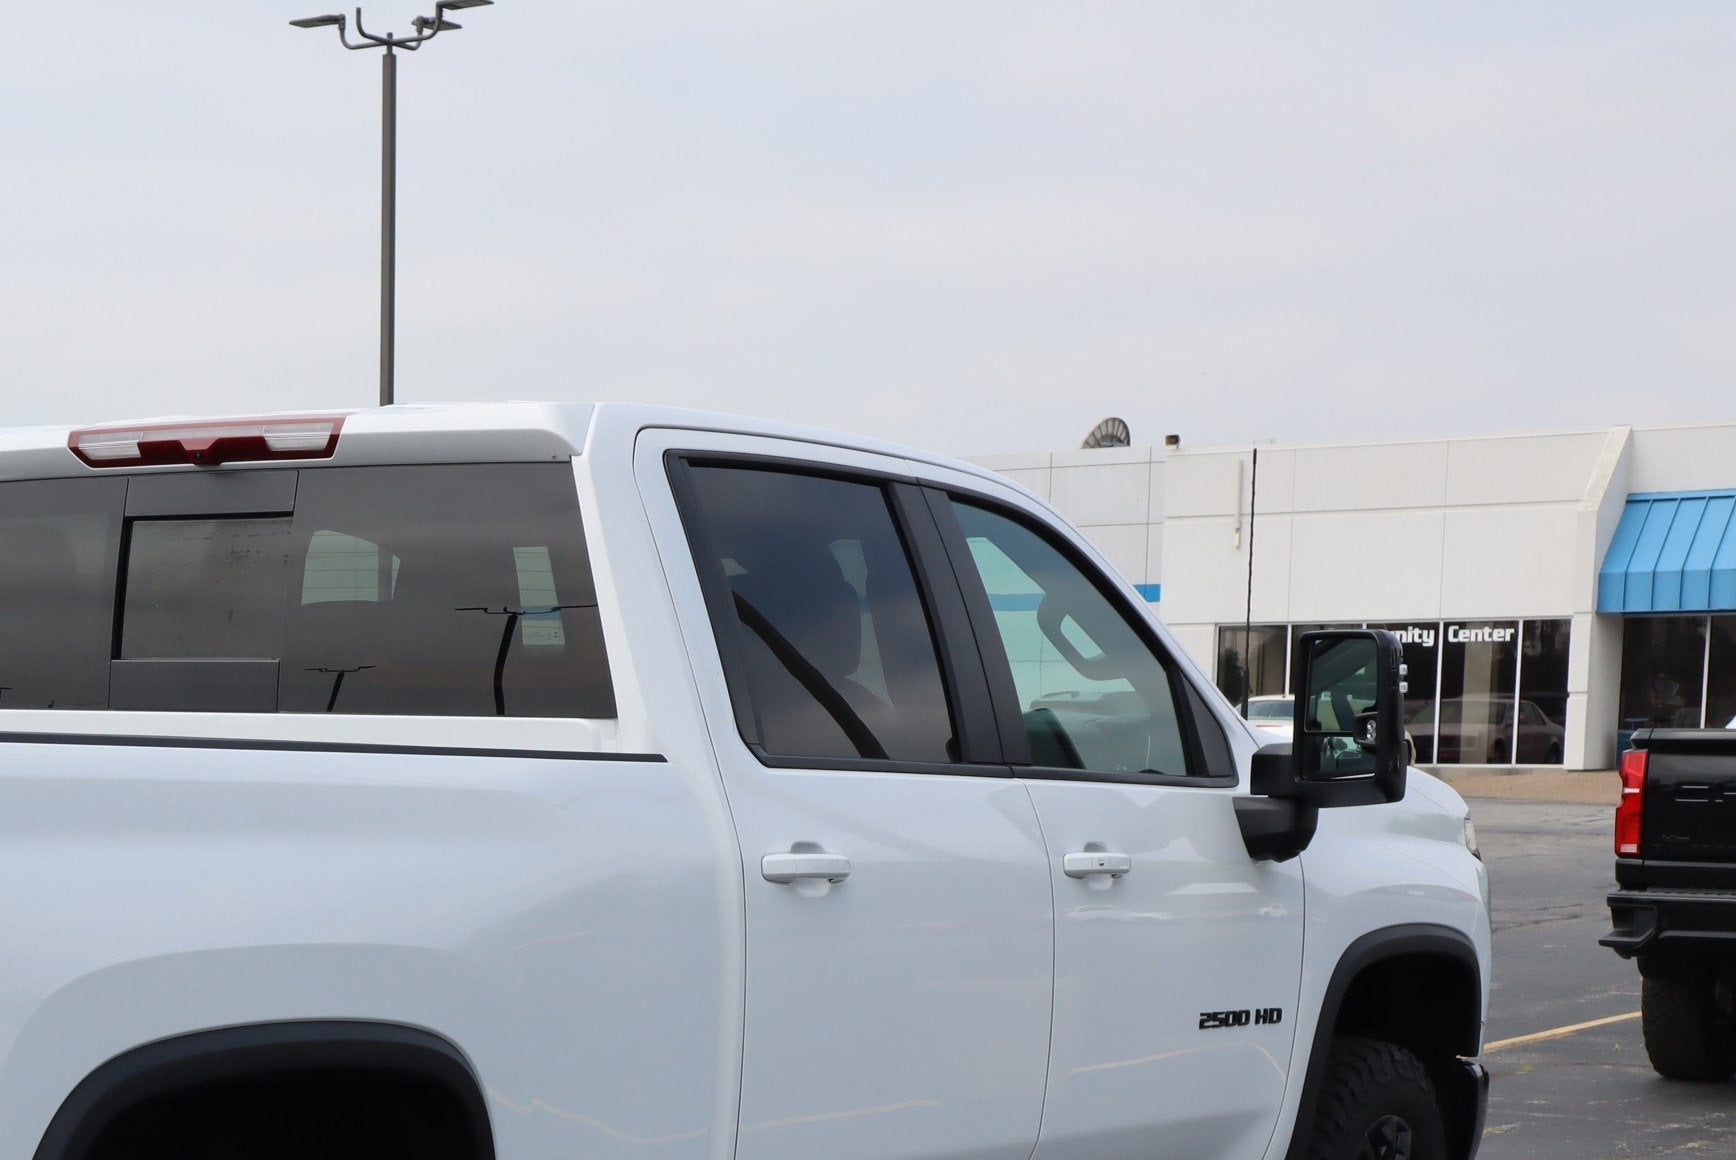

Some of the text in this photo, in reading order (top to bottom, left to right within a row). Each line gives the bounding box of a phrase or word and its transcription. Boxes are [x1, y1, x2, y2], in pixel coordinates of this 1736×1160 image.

[1448, 626, 1515, 642] Center
[1198, 1007, 1283, 1030] 2500 HD
